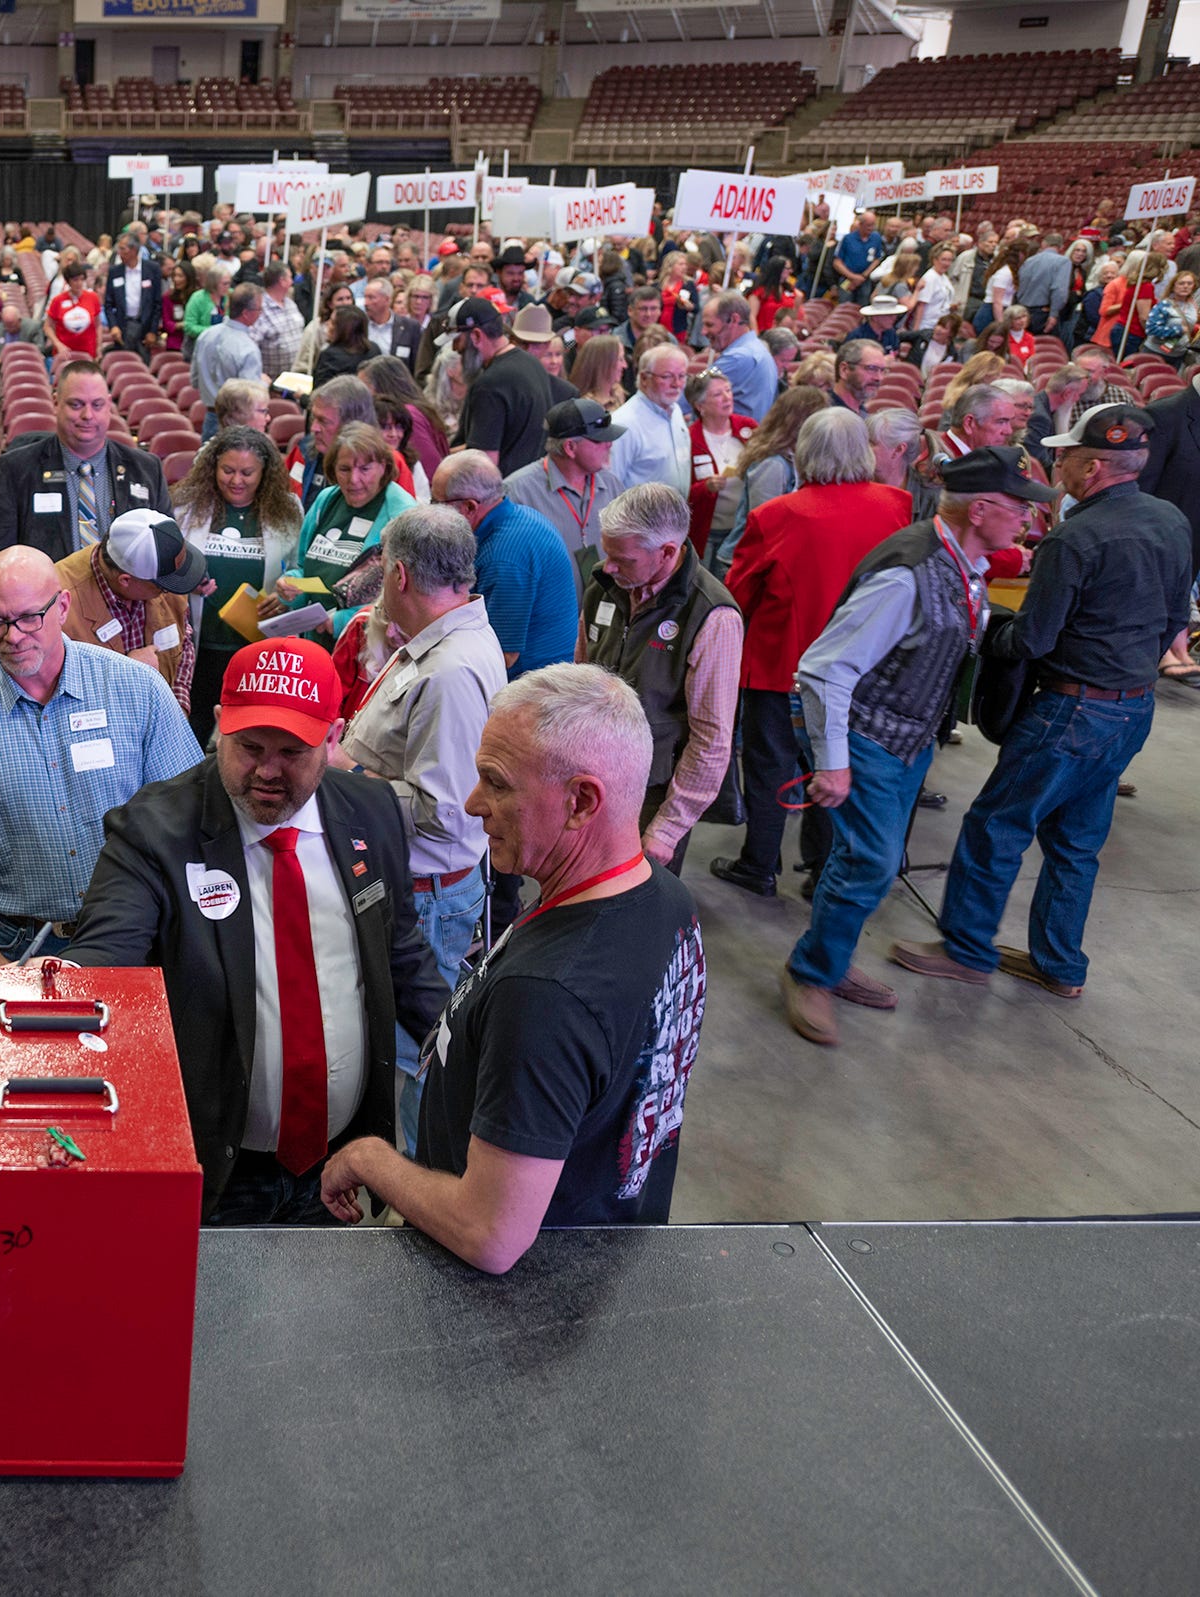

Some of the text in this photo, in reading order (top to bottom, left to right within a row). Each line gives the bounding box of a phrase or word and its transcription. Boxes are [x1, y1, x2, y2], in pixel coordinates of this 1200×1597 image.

[151, 174, 184, 187] WELD
[394, 179, 466, 204] DOUGLAS
[874, 181, 925, 201] PROWERS
[940, 172, 984, 191] PHILLIPS
[301, 188, 345, 222] LOGAN
[710, 184, 776, 222] ADAMS
[1138, 185, 1189, 211] DOUGLAS
[566, 195, 626, 231] ARAPAHOE
[256, 651, 303, 674] SAVE
[236, 672, 320, 703] AMERICA
[199, 882, 233, 896] LAUREN
